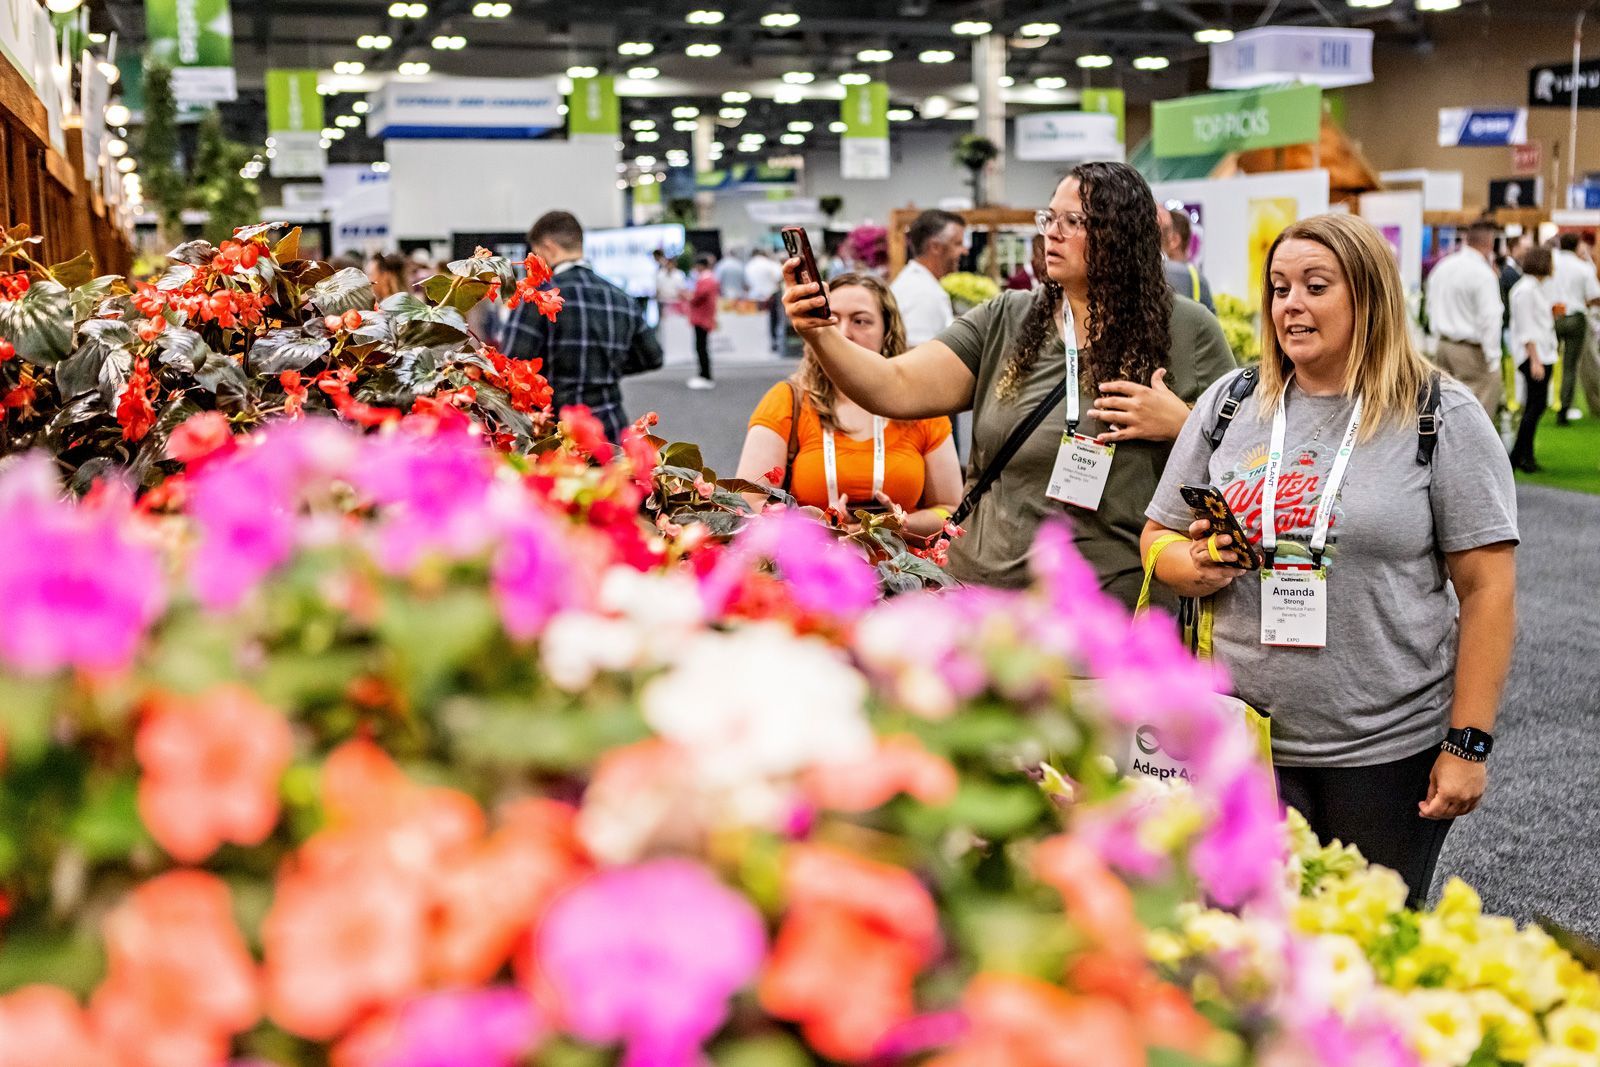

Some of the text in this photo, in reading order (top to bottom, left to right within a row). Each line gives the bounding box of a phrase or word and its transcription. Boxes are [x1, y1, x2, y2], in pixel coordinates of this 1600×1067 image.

[1193, 106, 1270, 142] TOP PICKS
[1345, 421, 1359, 447] PLANT
[1071, 453, 1097, 469] Cassy
[1249, 465, 1268, 478] THE
[1267, 461, 1277, 487] PLANT
[1285, 533, 1337, 544] MARET
[1272, 586, 1315, 597] Amanda
[1283, 598, 1305, 606] Strong
[1133, 758, 1177, 782] Adept
